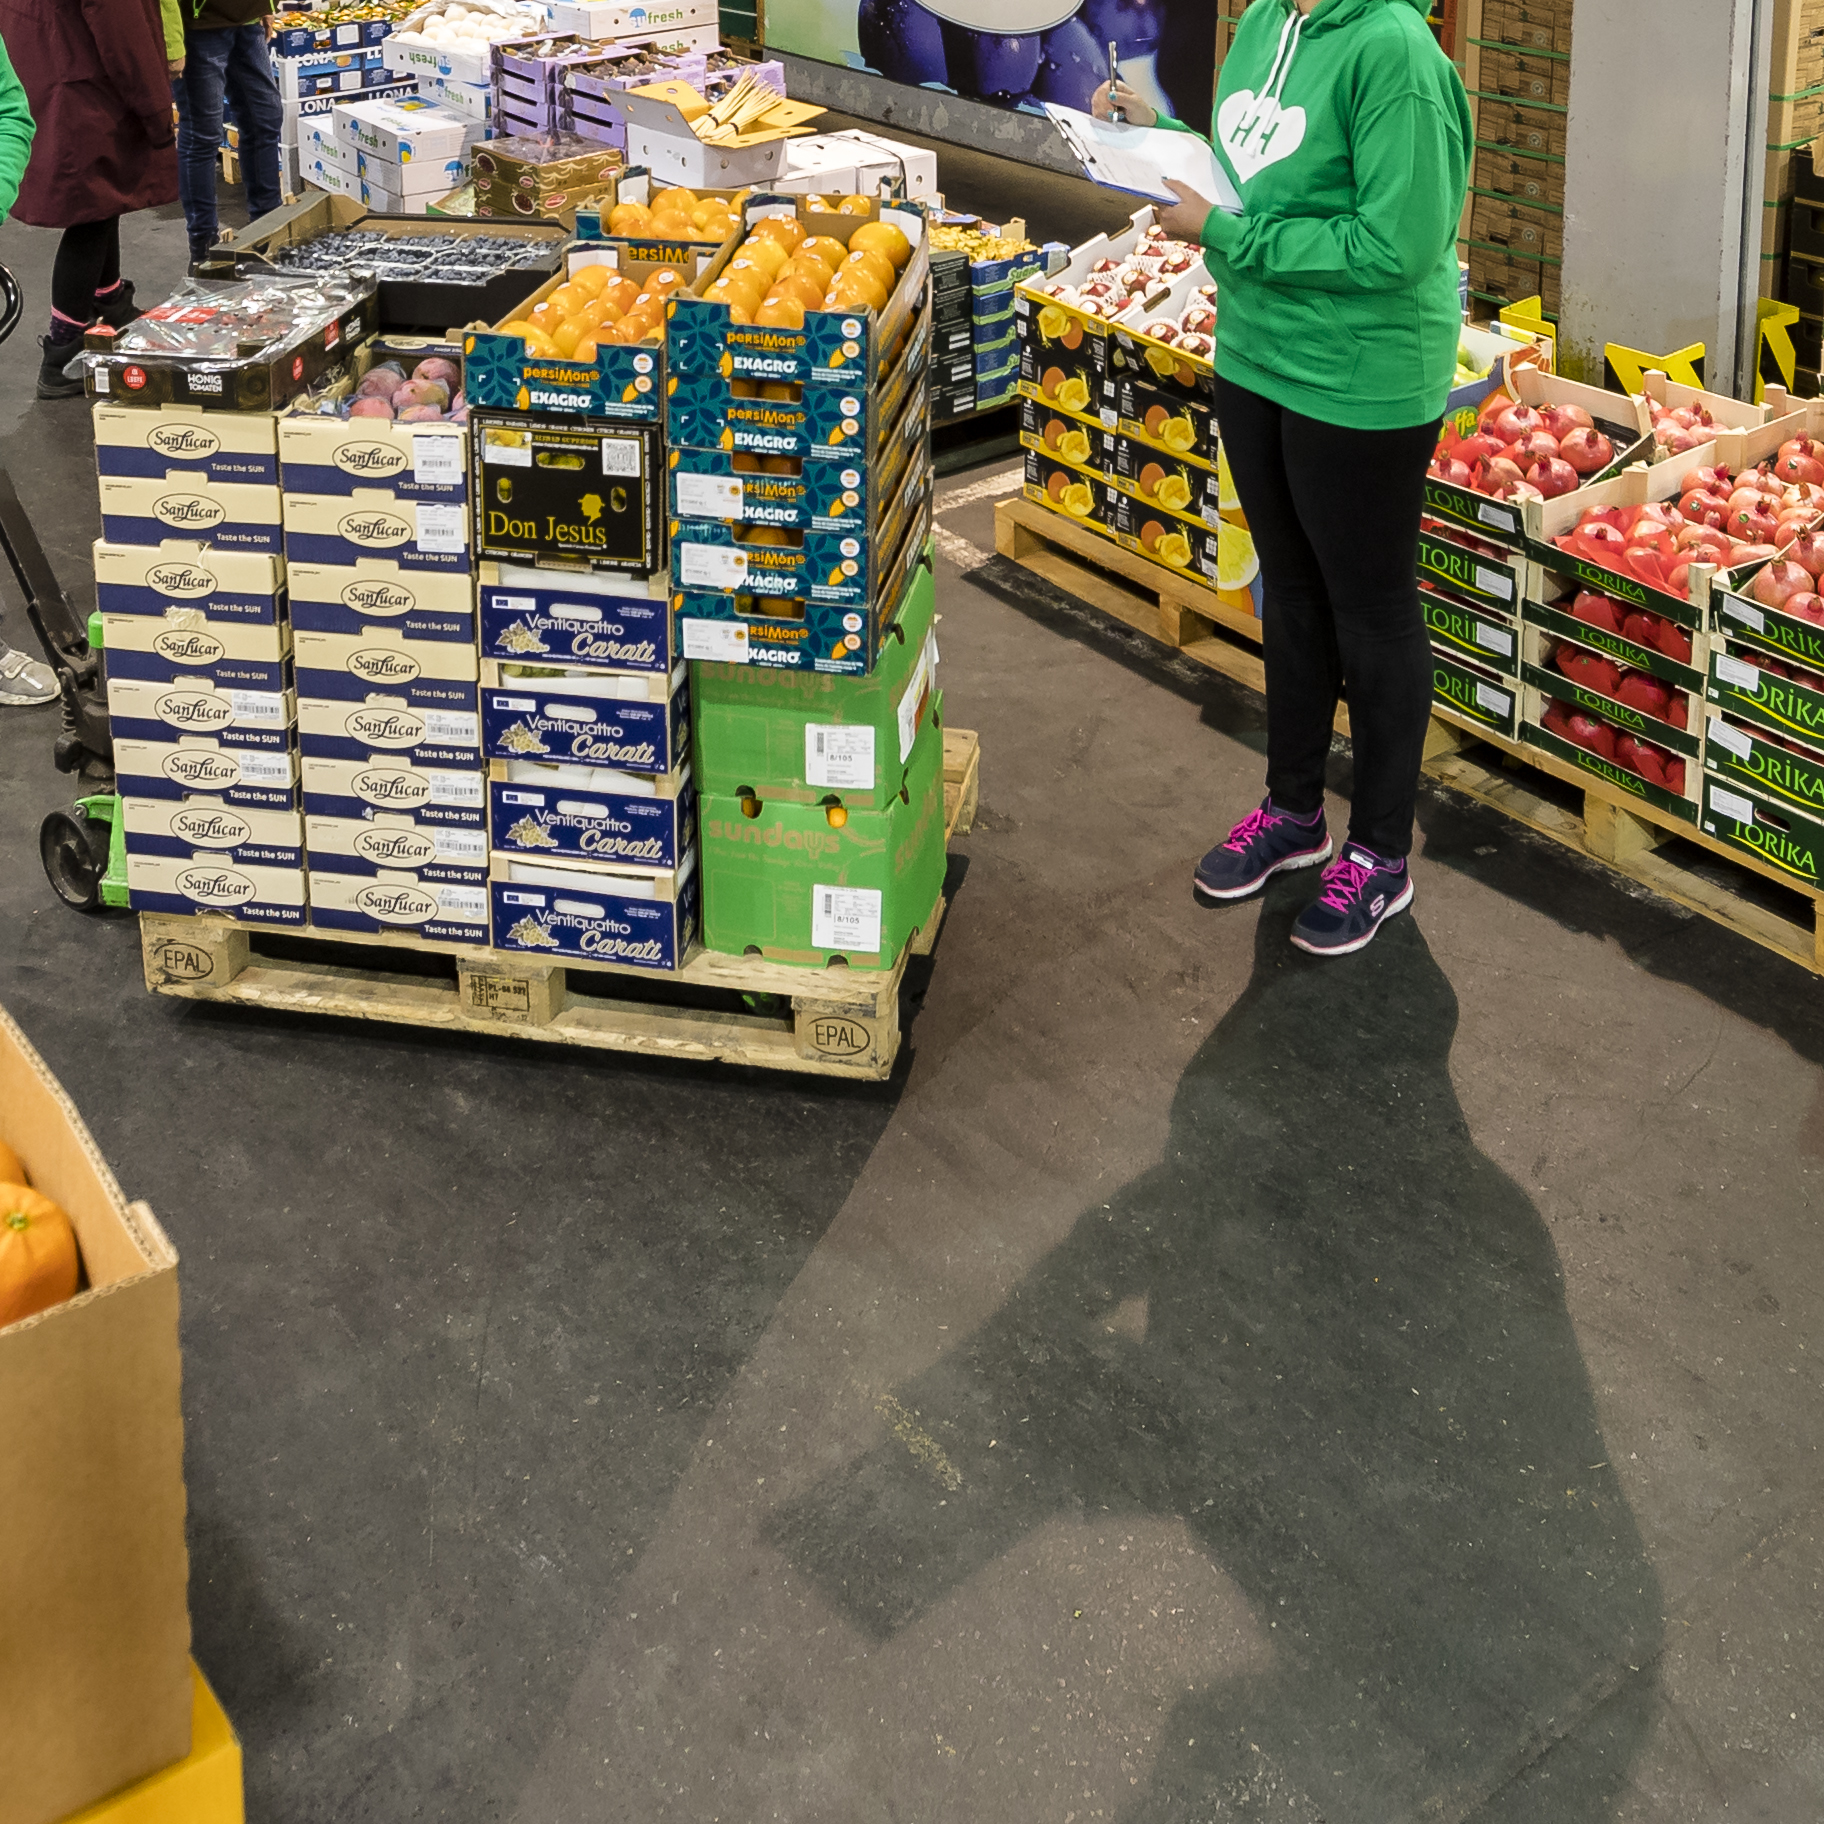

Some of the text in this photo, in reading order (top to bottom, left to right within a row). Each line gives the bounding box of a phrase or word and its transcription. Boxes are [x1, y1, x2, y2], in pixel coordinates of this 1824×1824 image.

[320, 141, 338, 159] fresh
[358, 132, 378, 149] fresh
[733, 356, 798, 374] EXAGRO
[188, 373, 222, 384] HONIG
[189, 382, 222, 393] TOMATEN
[530, 391, 591, 408] EXAGRO
[153, 432, 215, 458] SanLucar
[733, 433, 797, 450] EXAGRO
[339, 449, 402, 476] SanLucar
[488, 511, 537, 539] Don
[525, 613, 624, 636] Ventiquattro
[160, 636, 219, 662] SanLucar
[571, 633, 655, 663] Carati
[353, 655, 415, 682] SanLucar
[222, 732, 280, 743] Taste the SUN
[526, 714, 624, 738] Ventiquattro
[571, 735, 654, 764] Carati
[169, 757, 237, 786] SanLucar
[359, 775, 429, 805] SanLucar
[421, 809, 480, 822] Taste the SUN
[535, 809, 632, 833] Ventiquattro
[237, 848, 295, 861] Taste the SUN
[580, 830, 662, 858] Carati
[182, 873, 250, 904] SanLucar
[242, 907, 300, 919] Taste the SUN
[364, 891, 432, 922] SanLucar
[424, 925, 483, 937] Taste the SUN
[163, 948, 204, 974] EPAL
[815, 1022, 862, 1050] EPAL
